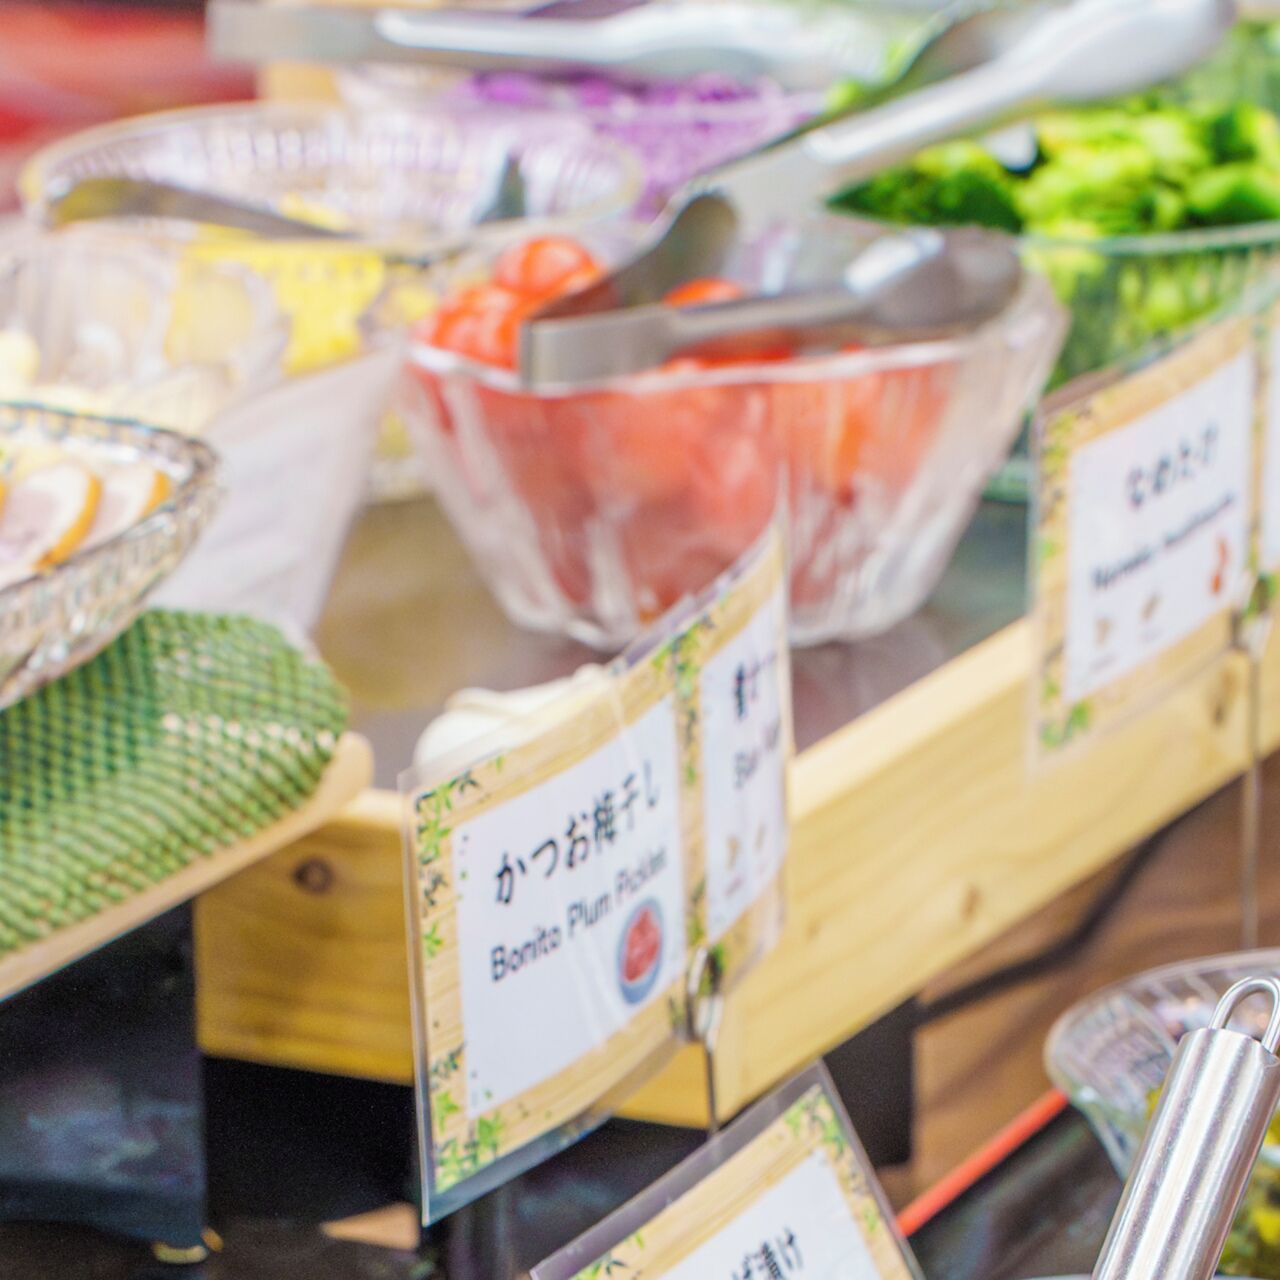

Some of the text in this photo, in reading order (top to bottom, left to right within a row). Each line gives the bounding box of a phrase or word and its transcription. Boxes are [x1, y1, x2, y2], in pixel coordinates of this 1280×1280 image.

[495, 758, 661, 905] かつお梅干し
[490, 924, 562, 983] Bonito
[567, 892, 613, 939] Plum
